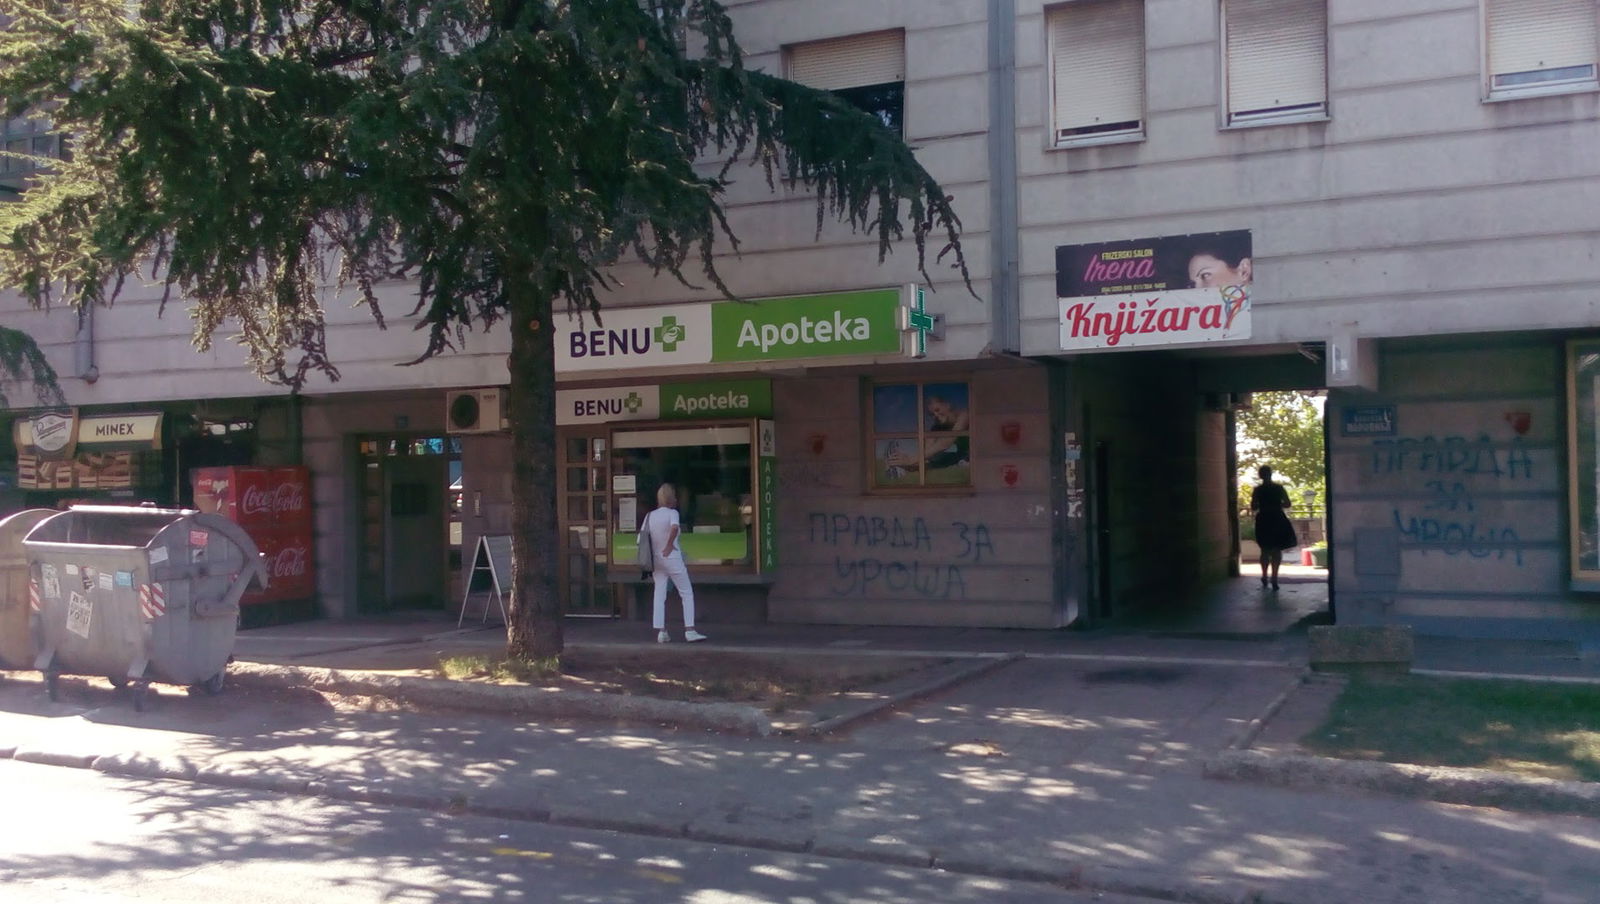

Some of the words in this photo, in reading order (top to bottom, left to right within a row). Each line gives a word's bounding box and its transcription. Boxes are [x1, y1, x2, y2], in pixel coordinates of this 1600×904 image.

[1084, 254, 1155, 282] Irena
[737, 310, 870, 352] Apoteka
[1066, 297, 1222, 346] Knjižara
[570, 327, 650, 358] BENU
[574, 398, 622, 416] BENU
[674, 391, 749, 414] Apoteka
[95, 423, 134, 436] MINEX
[808, 513, 931, 551] ПРАВДА
[952, 520, 997, 561] ЗА
[831, 556, 967, 598] УРОША
